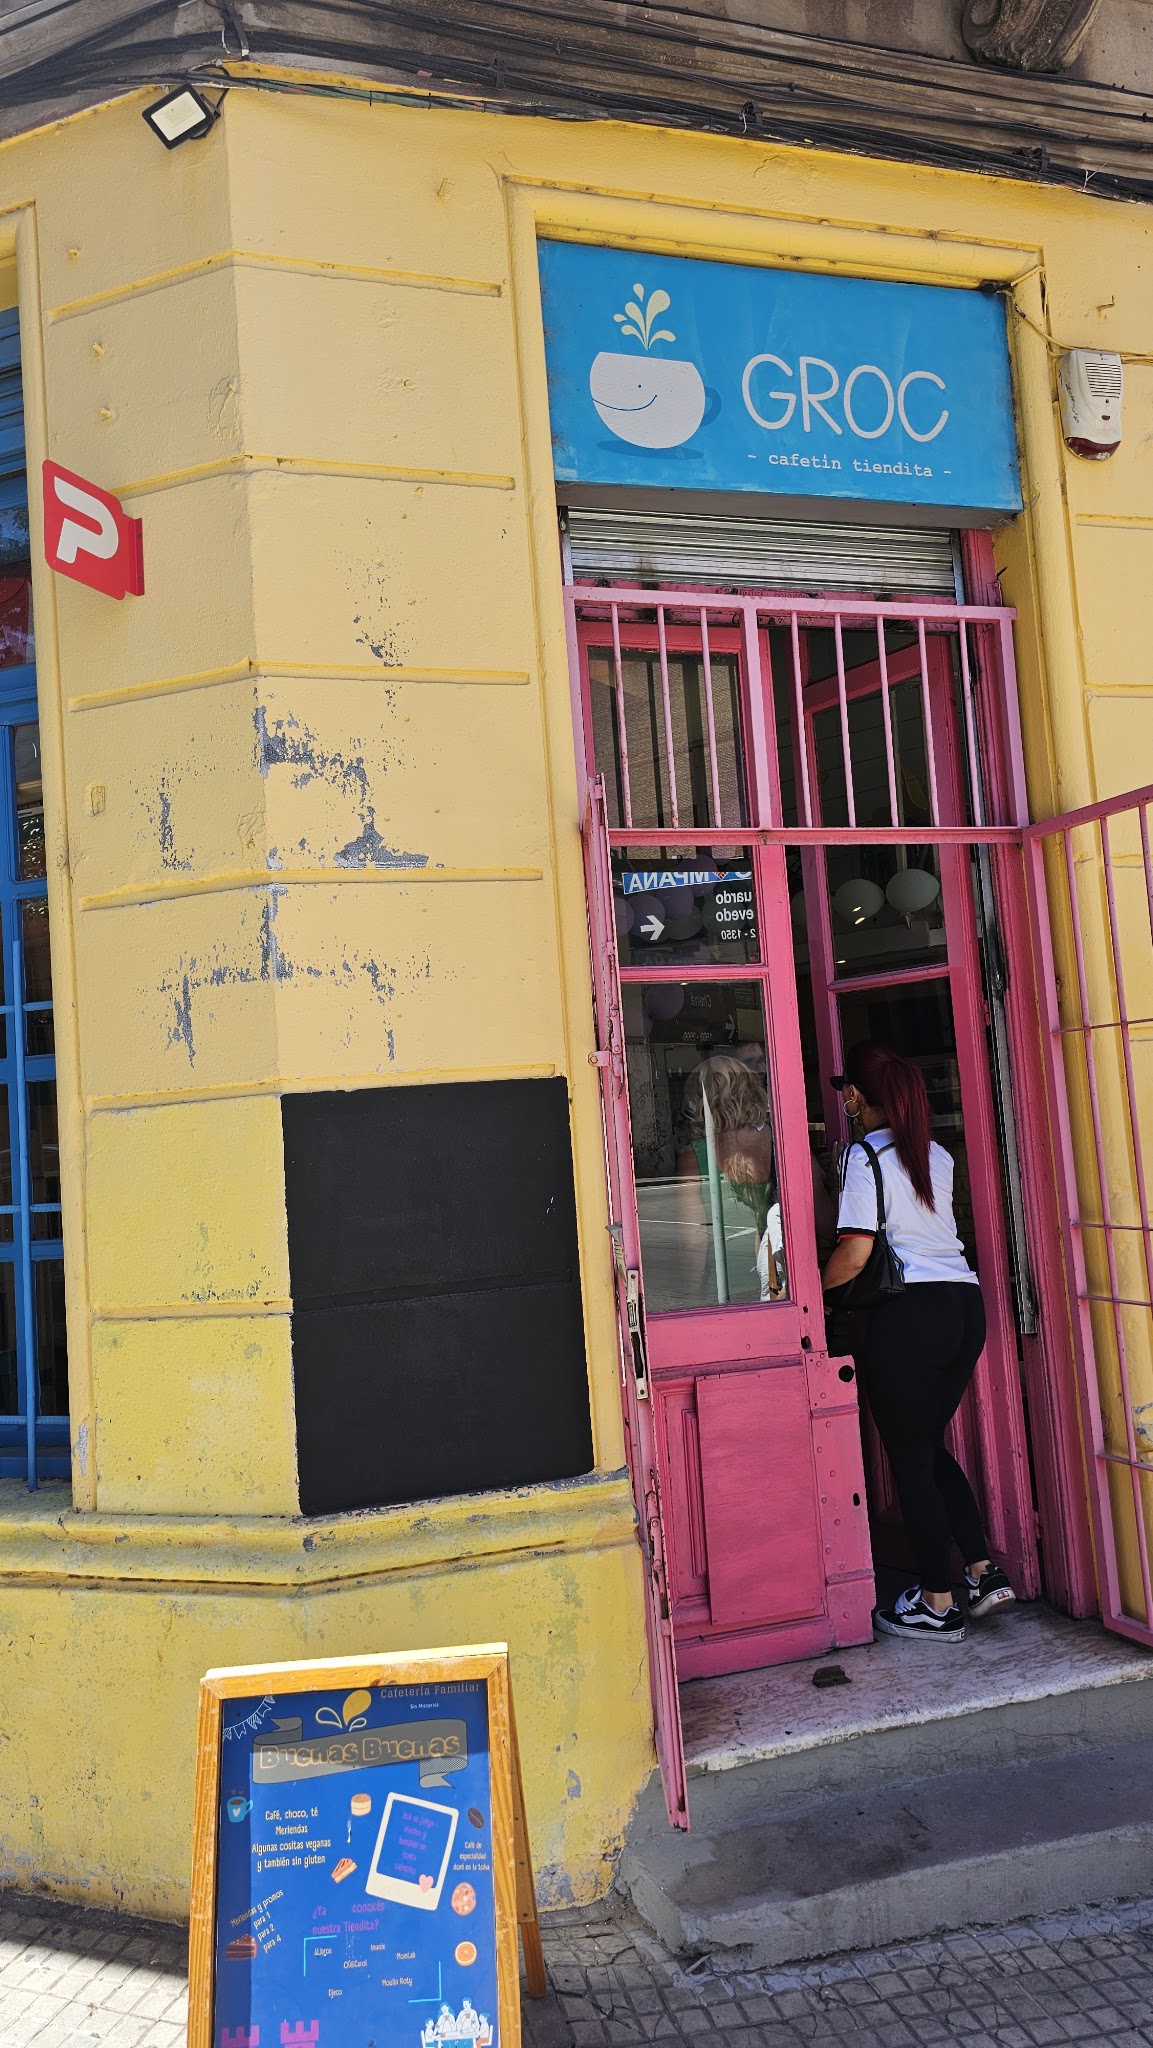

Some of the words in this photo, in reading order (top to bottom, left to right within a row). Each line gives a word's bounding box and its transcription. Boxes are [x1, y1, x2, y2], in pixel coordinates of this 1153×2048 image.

[742, 353, 949, 443] GROC
[853, 459, 933, 477] tiendita
[380, 1685, 430, 1699] Cafetería
[434, 1682, 480, 1695] Familiar
[260, 1742, 359, 1769] Buenas
[362, 1735, 461, 1761] Buenas
[265, 1809, 282, 1821] Café,
[284, 1809, 309, 1819] choco,
[310, 1806, 319, 1817] té
[275, 1824, 308, 1835] Meriendas
[251, 1843, 278, 1856] Algunas
[279, 1841, 304, 1851] cositas
[305, 1839, 331, 1852] veganas
[257, 1860, 262, 1872] y
[264, 1856, 290, 1868] también
[291, 1855, 302, 1865] sin
[304, 1855, 326, 1868] gluten
[230, 1906, 257, 1928] Meriendas
[262, 1889, 284, 1909] promos
[312, 1905, 327, 1919] ¿Ya
[253, 1915, 266, 1930] para
[312, 1924, 341, 1935] nuestra
[344, 1919, 380, 1932] Tiendita?
[257, 1928, 270, 1943] para
[269, 1923, 275, 1932] 2
[263, 1939, 276, 1954] para
[276, 1934, 282, 1942] 4
